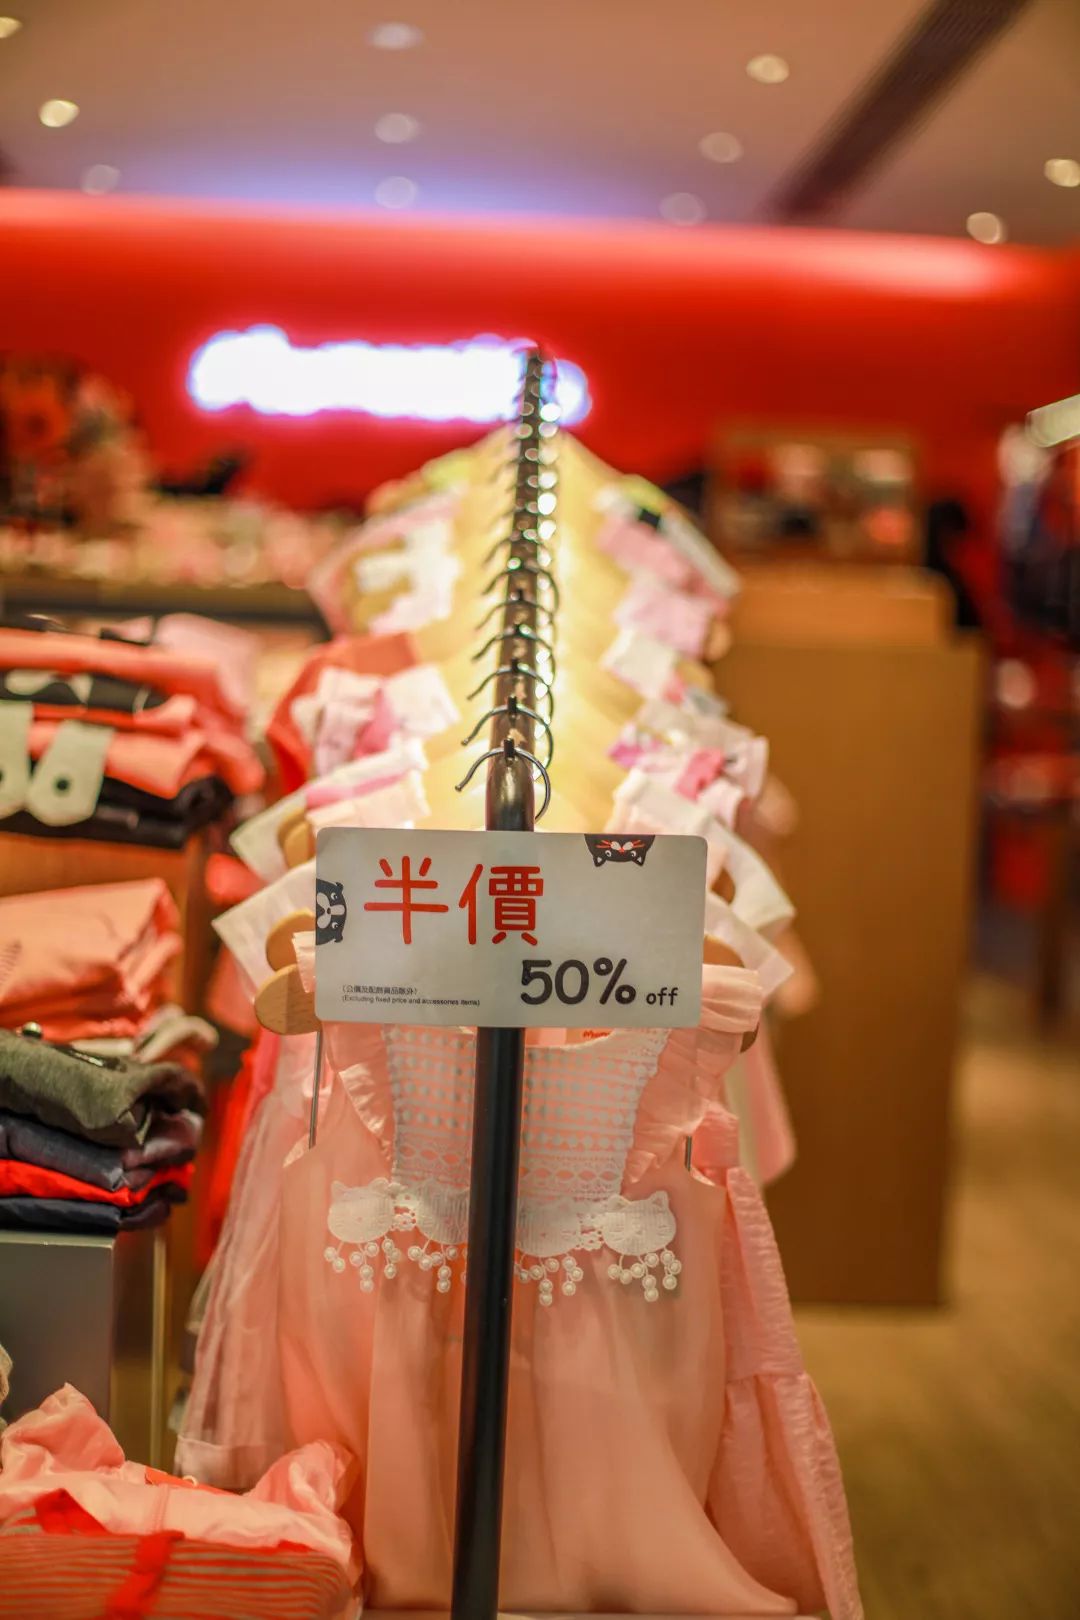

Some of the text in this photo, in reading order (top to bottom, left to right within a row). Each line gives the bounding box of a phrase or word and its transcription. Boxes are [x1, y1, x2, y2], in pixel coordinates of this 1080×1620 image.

[364, 855, 544, 946] 半價
[392, 997, 407, 1005] price
[520, 957, 679, 1006] 50% off
